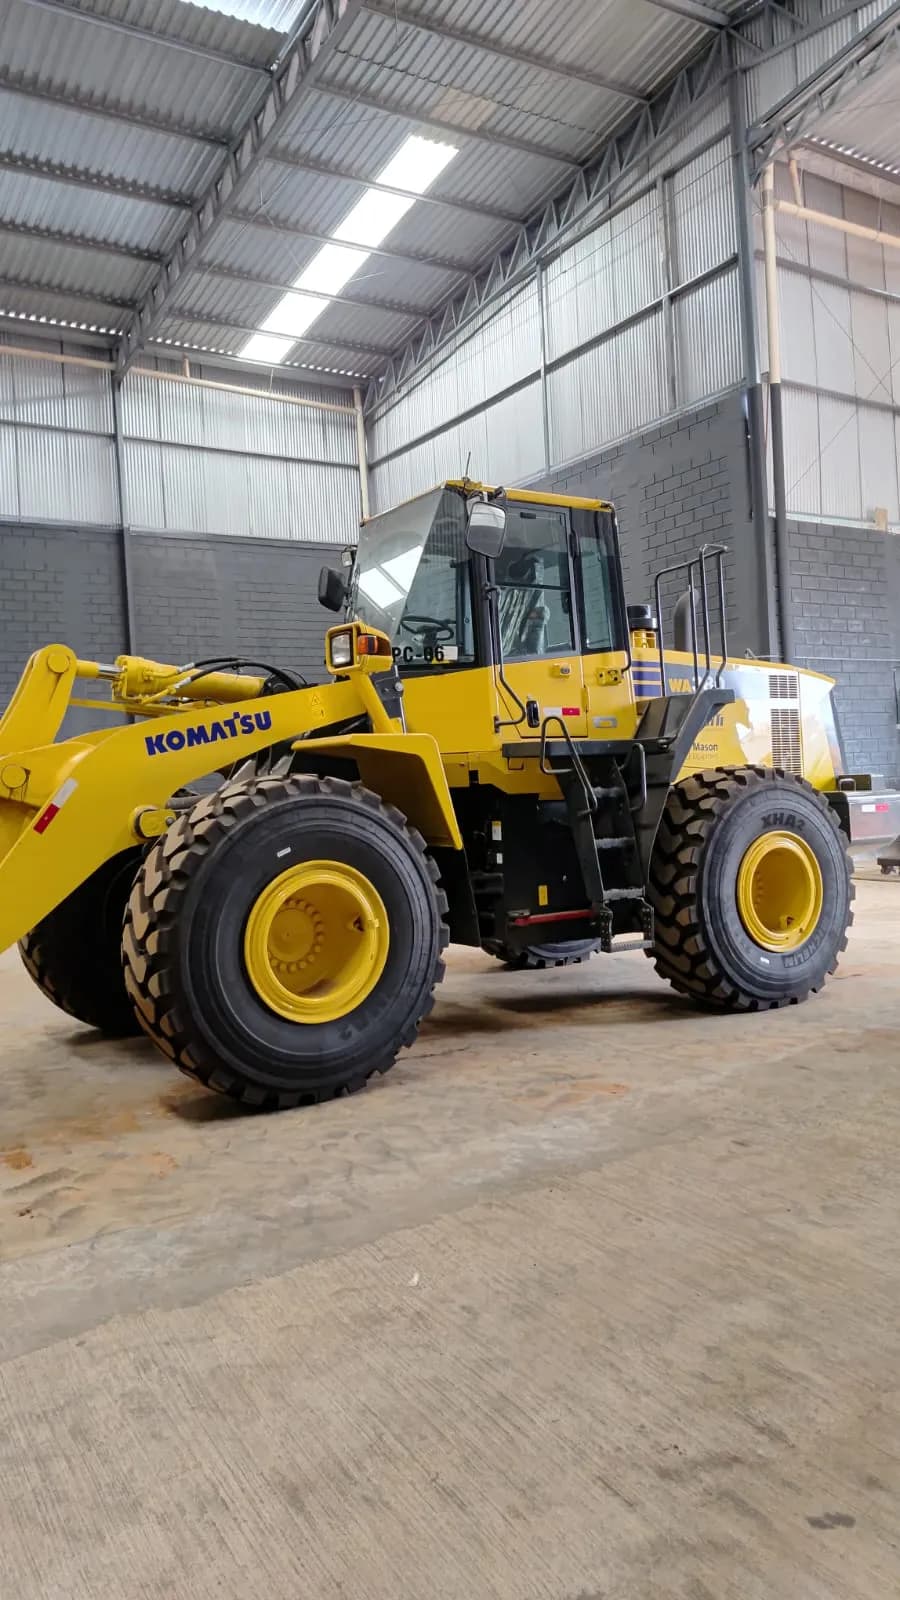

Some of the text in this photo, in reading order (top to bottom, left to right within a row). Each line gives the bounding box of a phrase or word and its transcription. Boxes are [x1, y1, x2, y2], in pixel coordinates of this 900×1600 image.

[144, 711, 272, 757] KOMATSU
[761, 812, 805, 831] XHA2
[781, 921, 828, 969] ICHELIN
